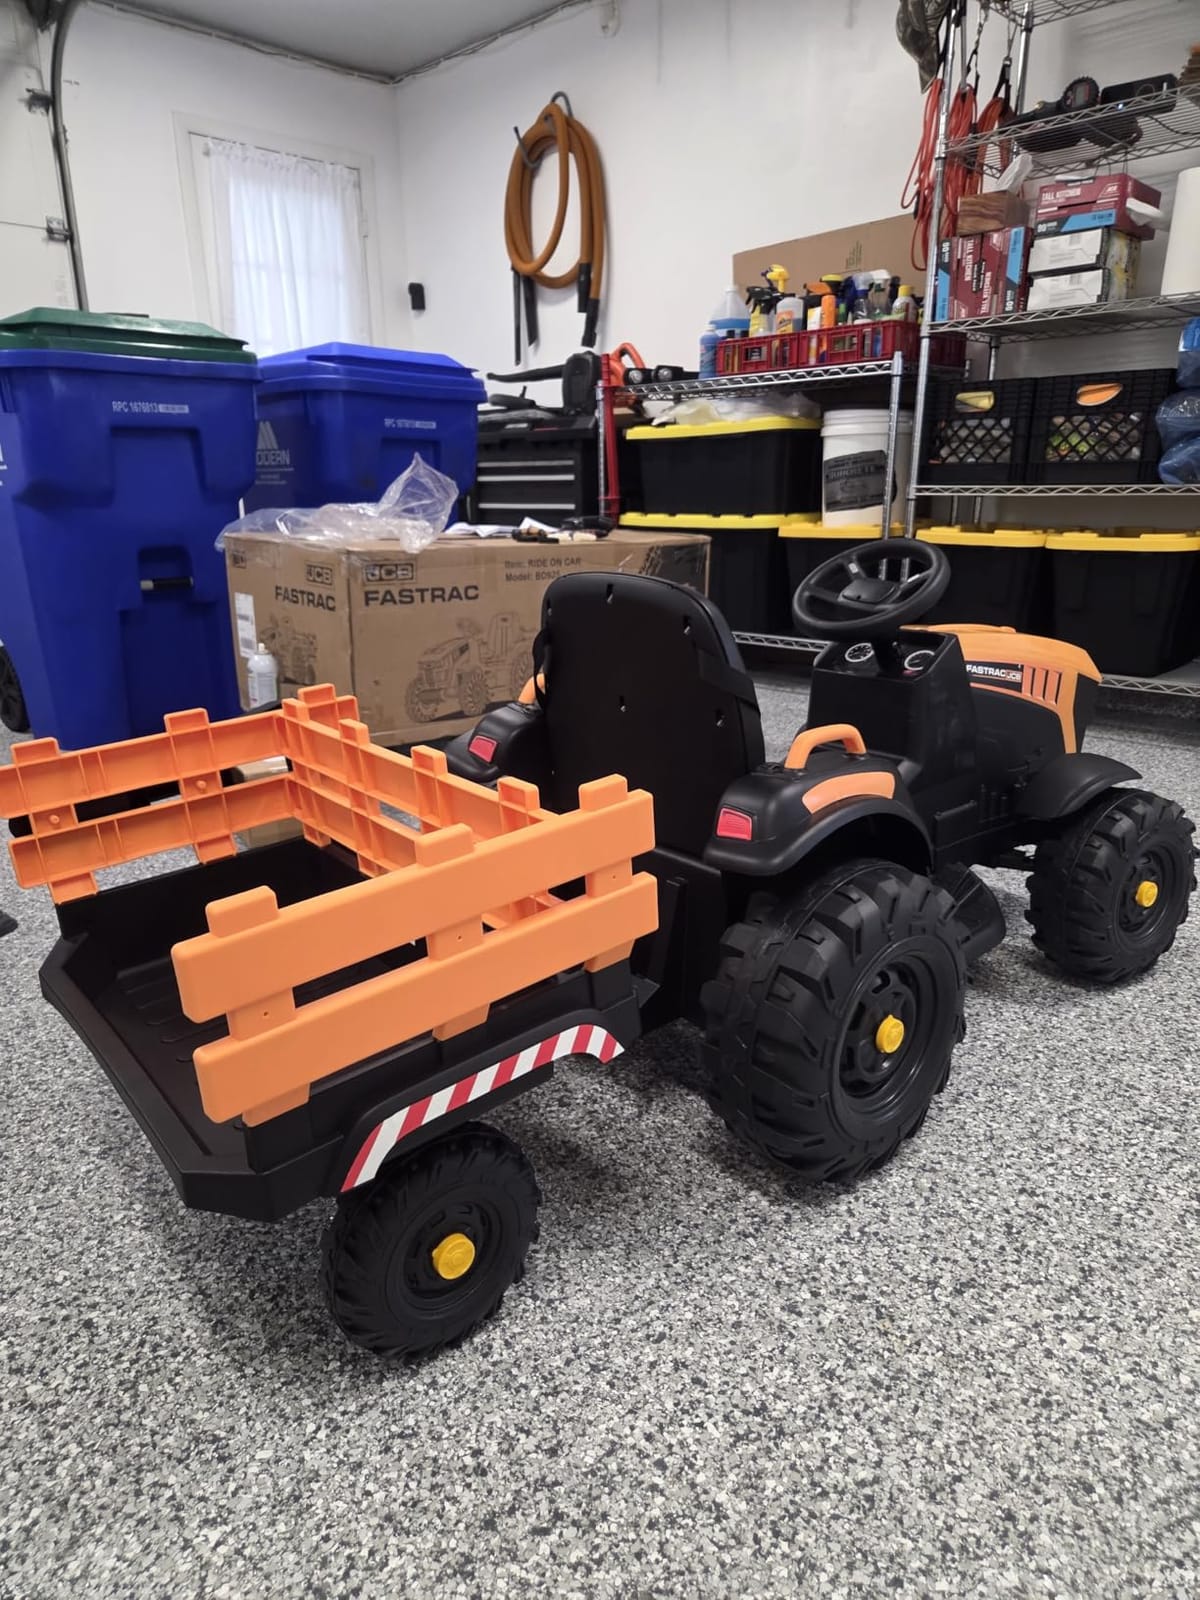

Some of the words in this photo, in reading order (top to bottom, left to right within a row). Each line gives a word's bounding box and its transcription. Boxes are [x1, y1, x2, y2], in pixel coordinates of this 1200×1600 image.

[112, 401, 128, 412] RPC
[256, 450, 290, 465] ODERN
[528, 559, 548, 569] RIDE
[550, 558, 562, 567] ON
[564, 557, 581, 567] CAR
[306, 564, 333, 585] JCB
[365, 563, 414, 582] JCB
[275, 585, 336, 612] FASTRAC
[364, 585, 480, 607] FASTRAC
[966, 664, 1006, 678] FASTRAC
